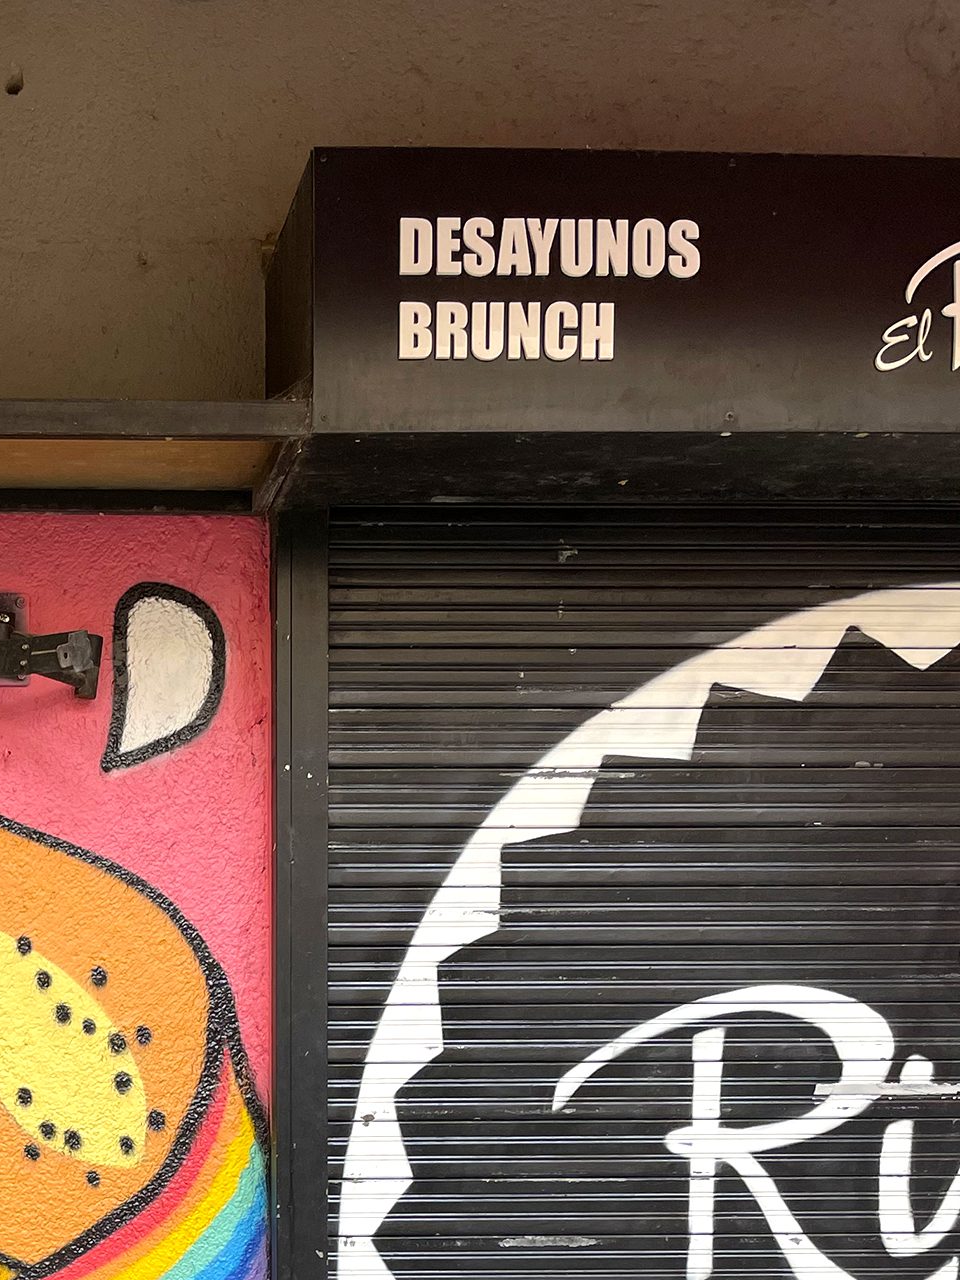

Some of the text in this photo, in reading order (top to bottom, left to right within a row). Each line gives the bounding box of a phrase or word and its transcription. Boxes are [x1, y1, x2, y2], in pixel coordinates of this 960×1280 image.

[398, 216, 701, 279] DESAYUNOS
[398, 300, 615, 361] BRUNCH
[874, 308, 933, 371] El
